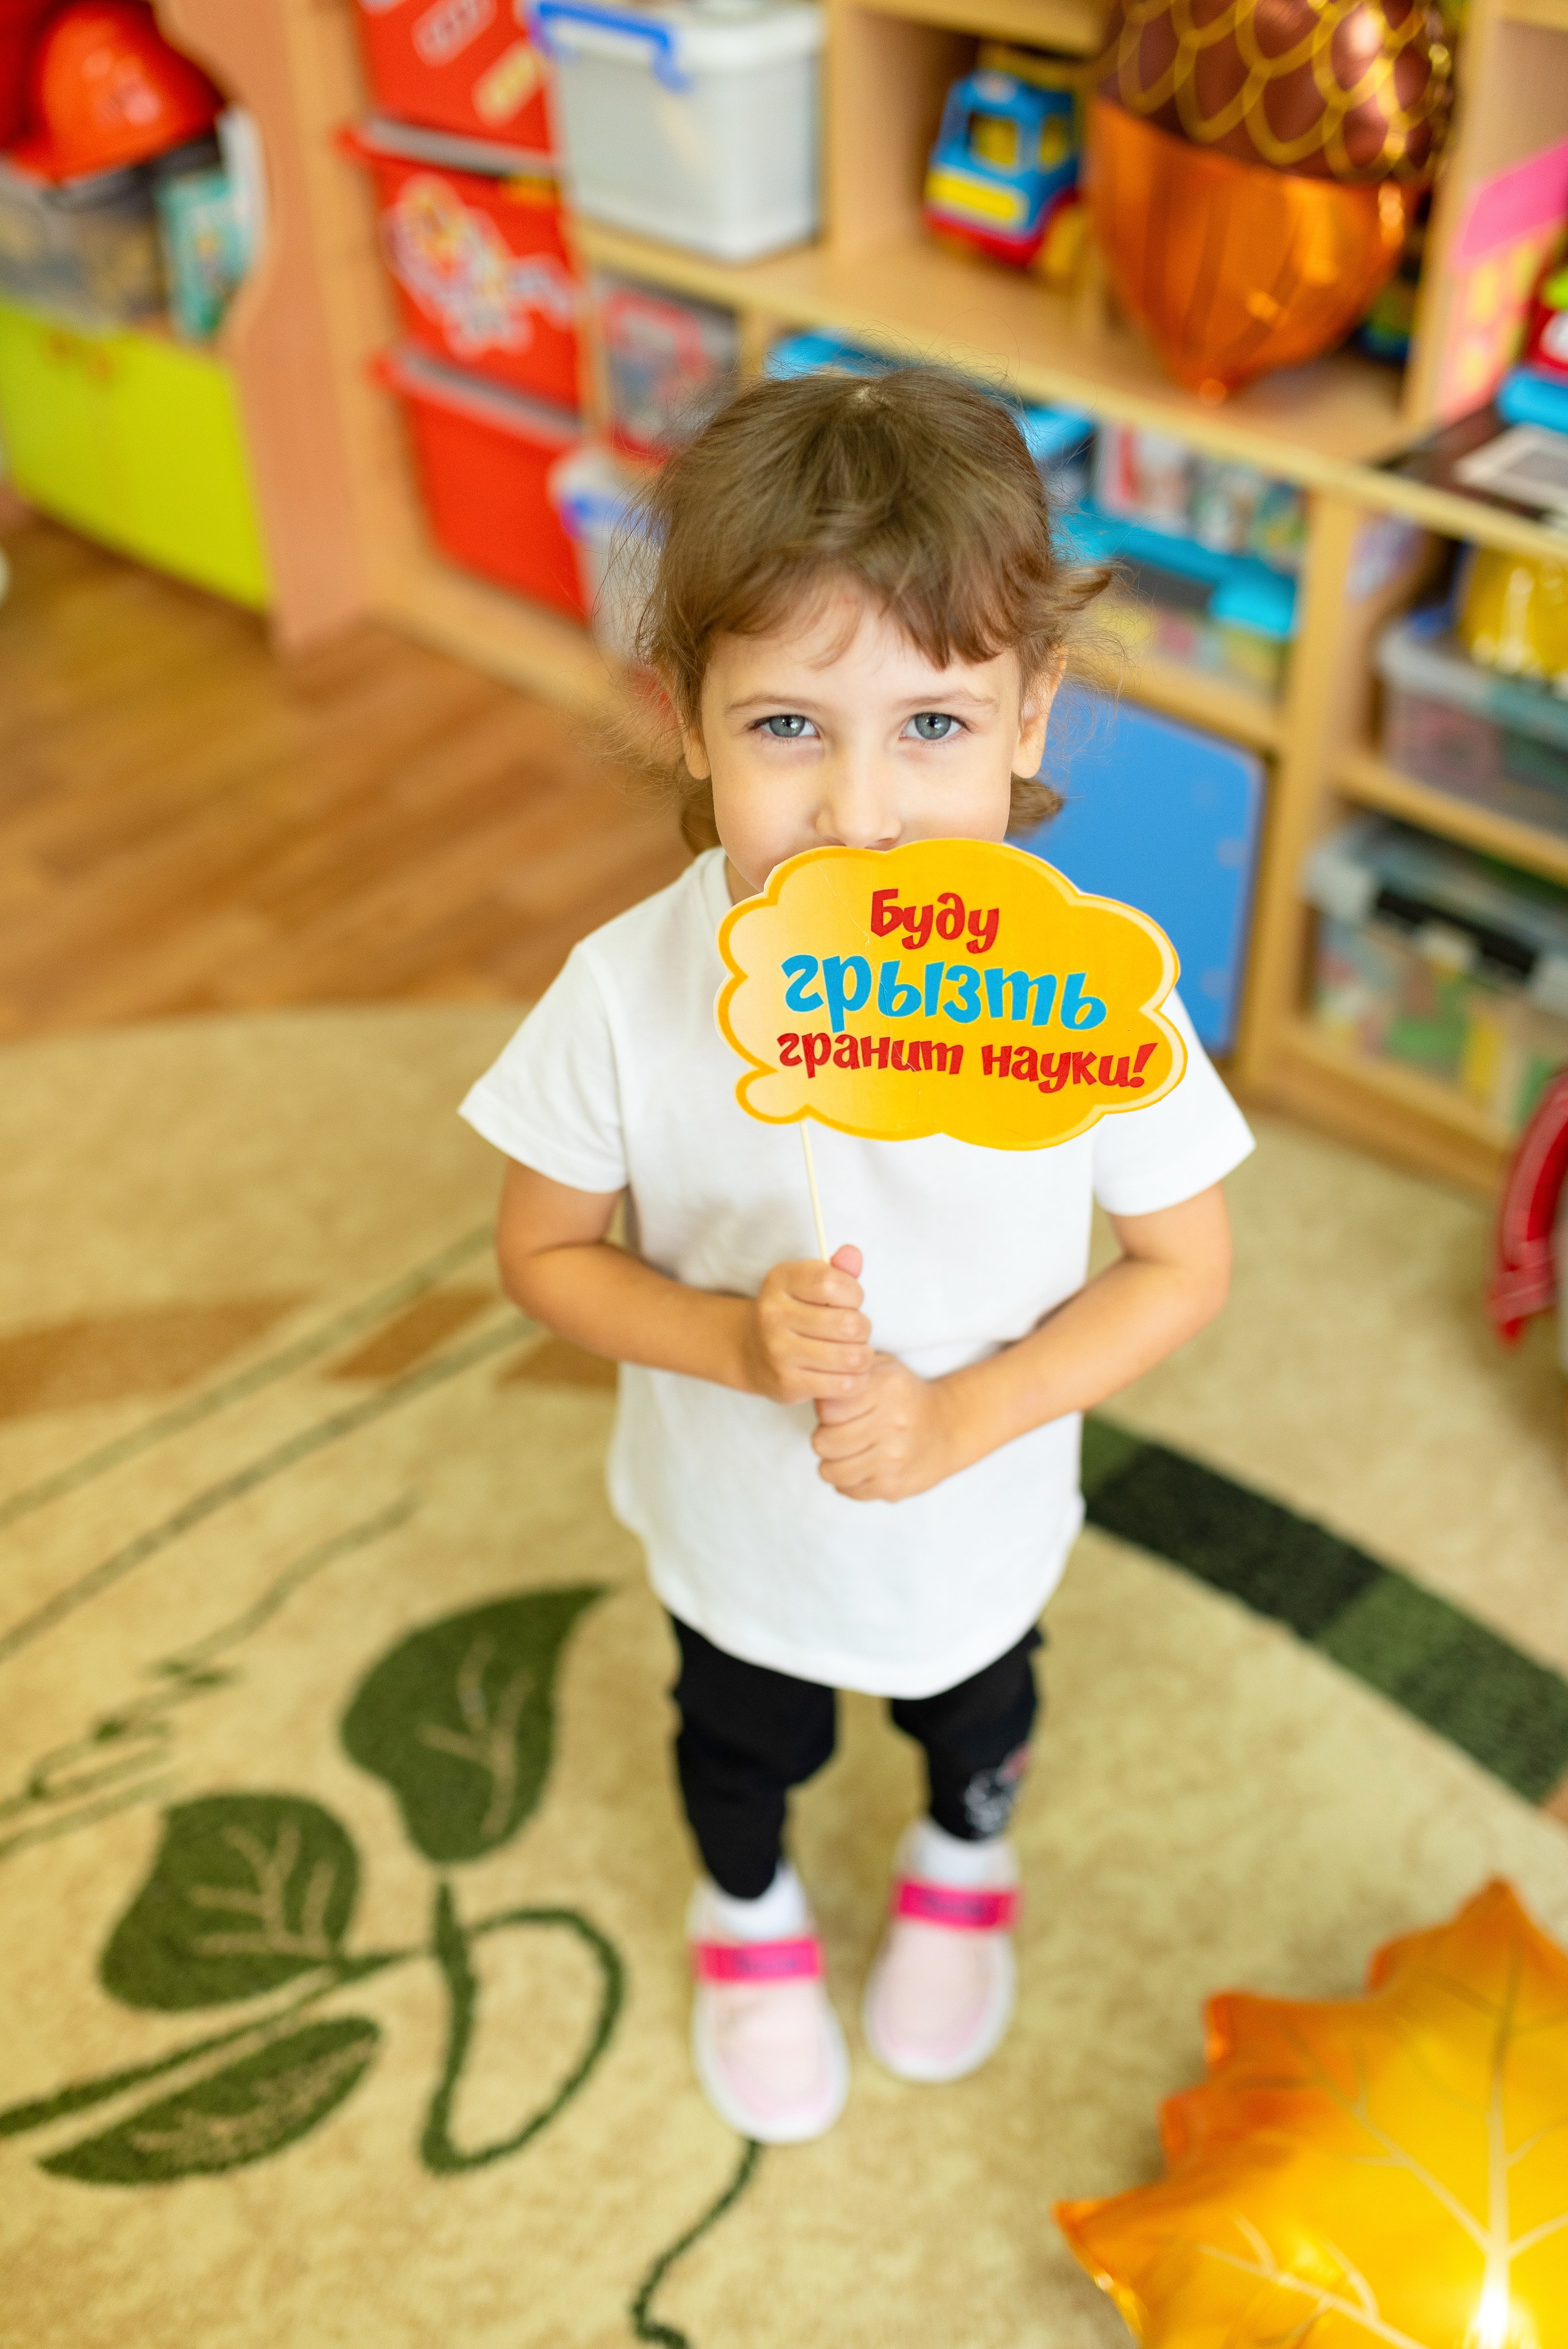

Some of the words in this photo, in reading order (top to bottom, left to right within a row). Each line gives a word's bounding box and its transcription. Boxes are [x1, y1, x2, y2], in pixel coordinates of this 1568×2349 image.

[870, 888, 1000, 954] Буду
[781, 954, 1107, 1033] грызть
[777, 1032, 964, 1079] гранит
[981, 1043, 1159, 1094] науки!
